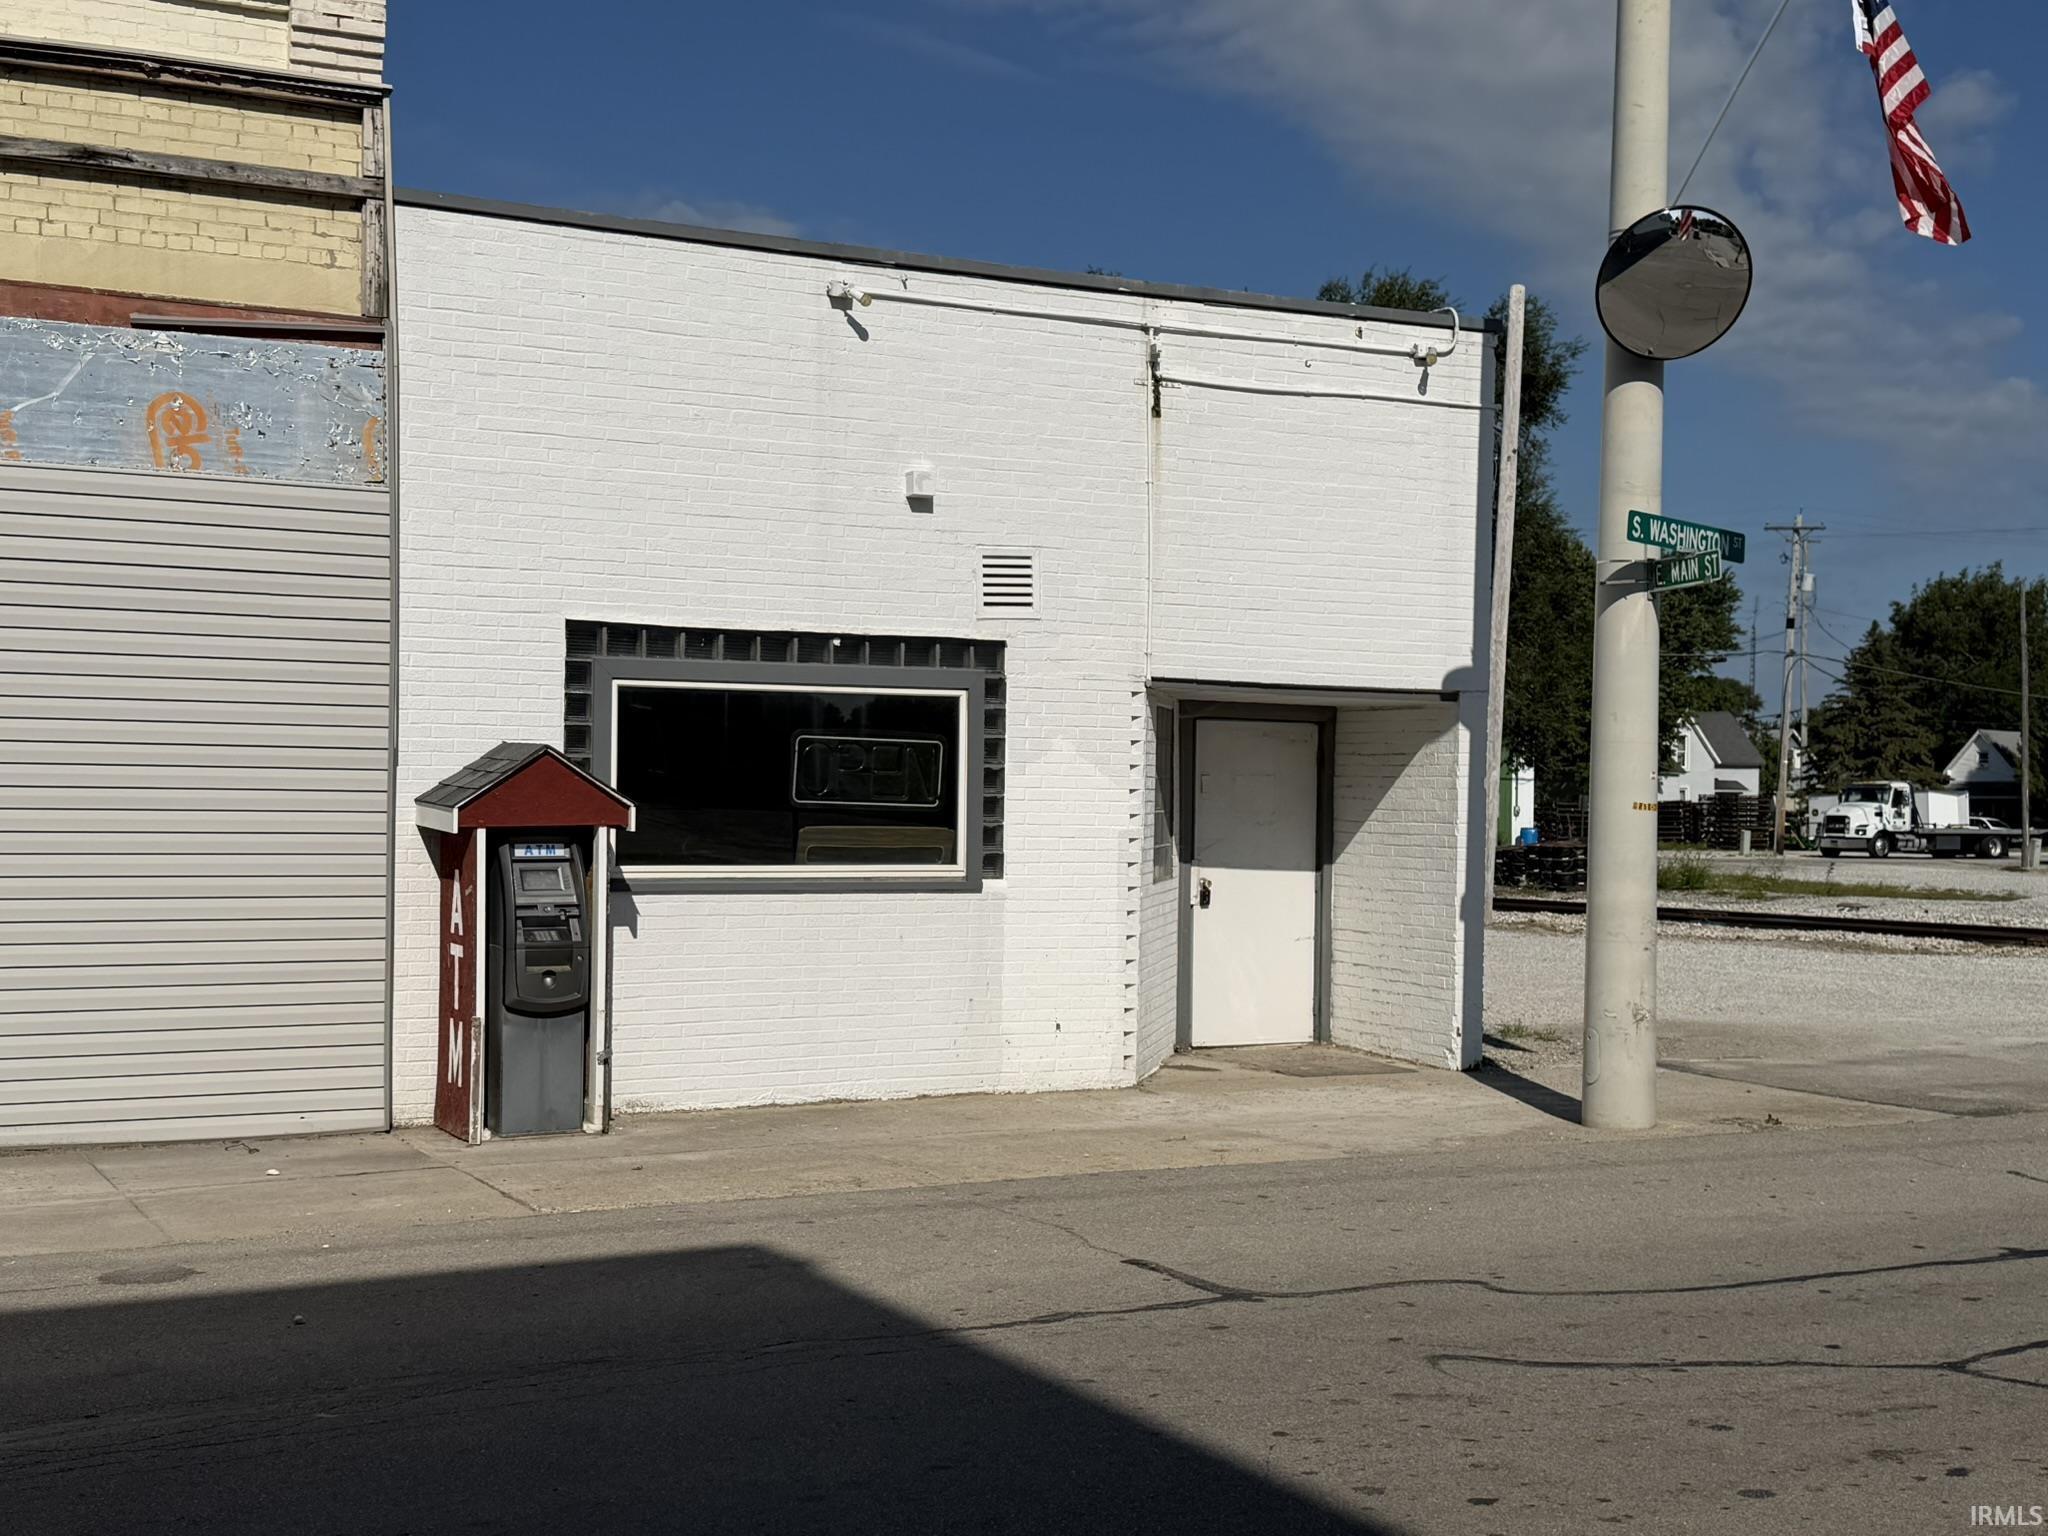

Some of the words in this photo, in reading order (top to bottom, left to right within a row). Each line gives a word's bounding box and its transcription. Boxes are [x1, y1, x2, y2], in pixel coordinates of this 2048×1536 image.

[1632, 515, 1644, 538] S.
[1650, 518, 1729, 555] WASHINGTON
[1733, 538, 1743, 549] ST
[1656, 564, 1665, 585] E.
[1671, 562, 1699, 583] MAIN
[1705, 554, 1719, 576] ST
[802, 742, 936, 801] OPEN
[524, 844, 556, 856] ATM
[447, 869, 464, 1088] ATM
